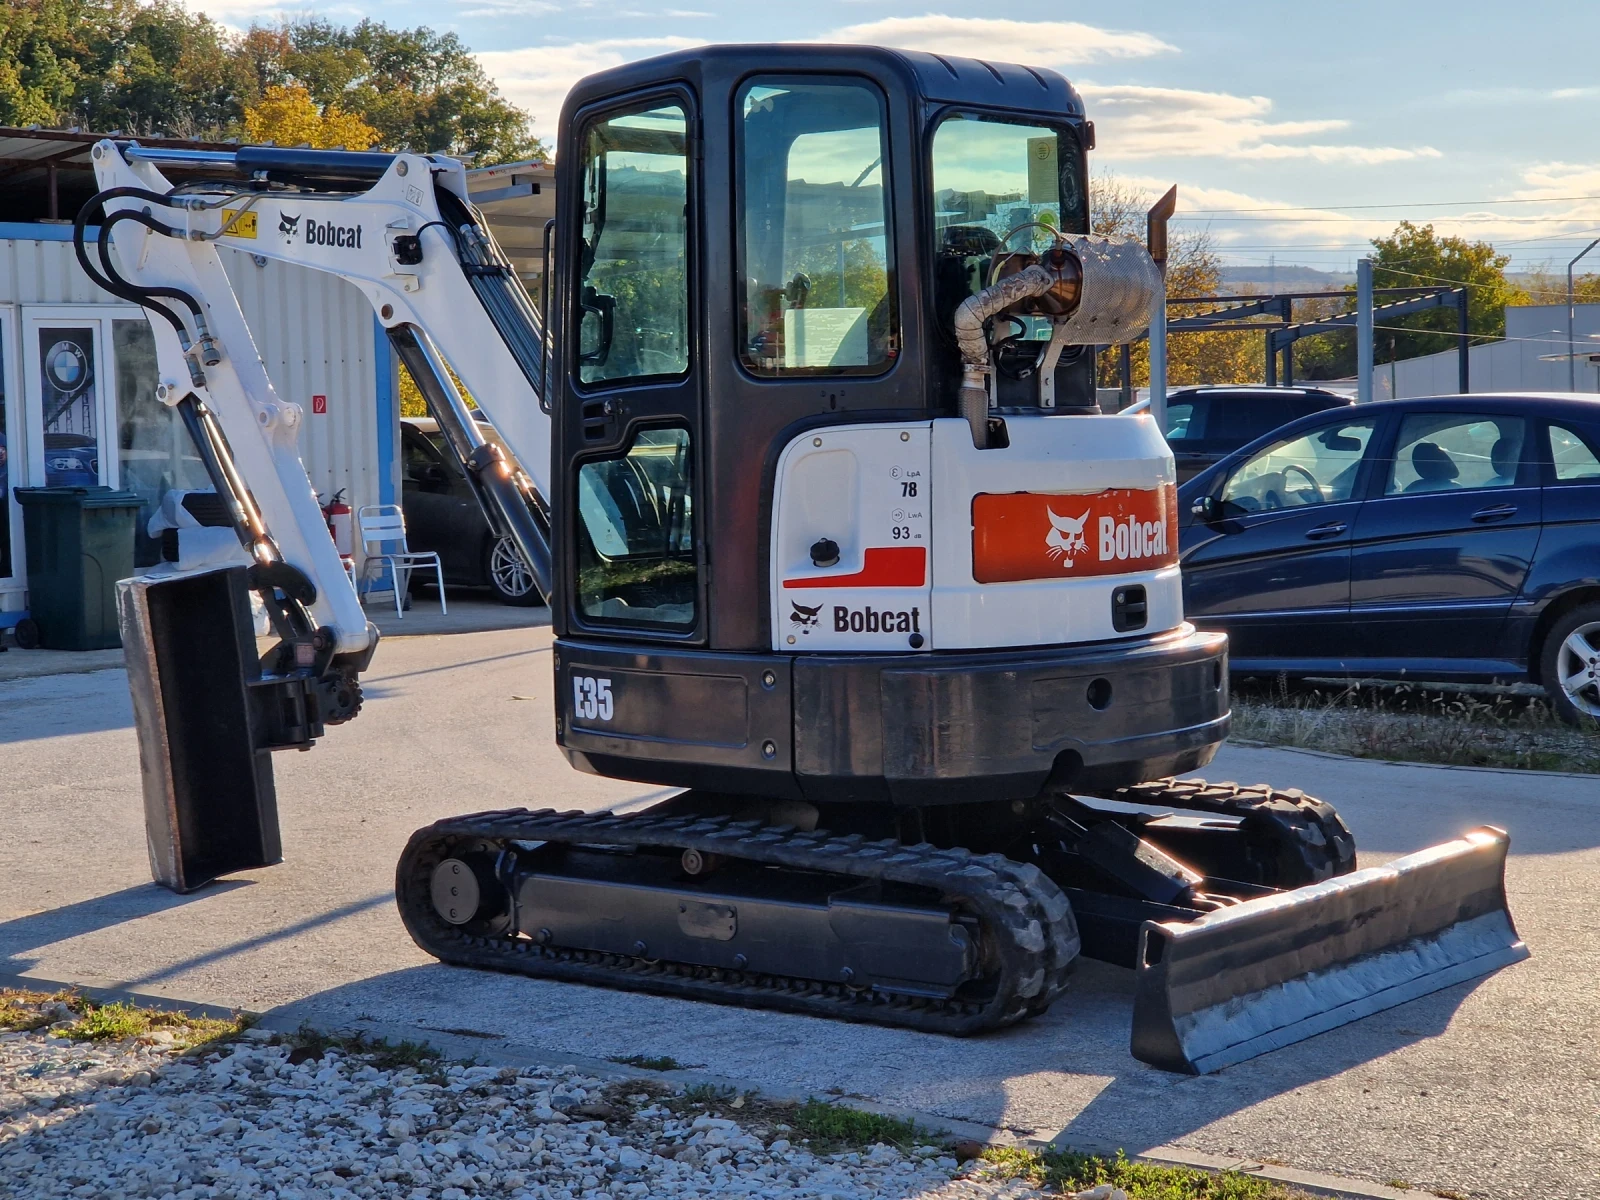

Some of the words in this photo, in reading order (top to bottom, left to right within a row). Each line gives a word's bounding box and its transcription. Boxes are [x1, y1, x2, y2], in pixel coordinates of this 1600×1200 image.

[306, 218, 362, 249] Bobcat
[906, 470, 921, 478] LpA
[901, 481, 918, 498] 78
[892, 526, 911, 540] 93
[1098, 514, 1168, 562] Bobcat
[833, 606, 920, 633] Bobcat
[573, 676, 614, 721] E35
